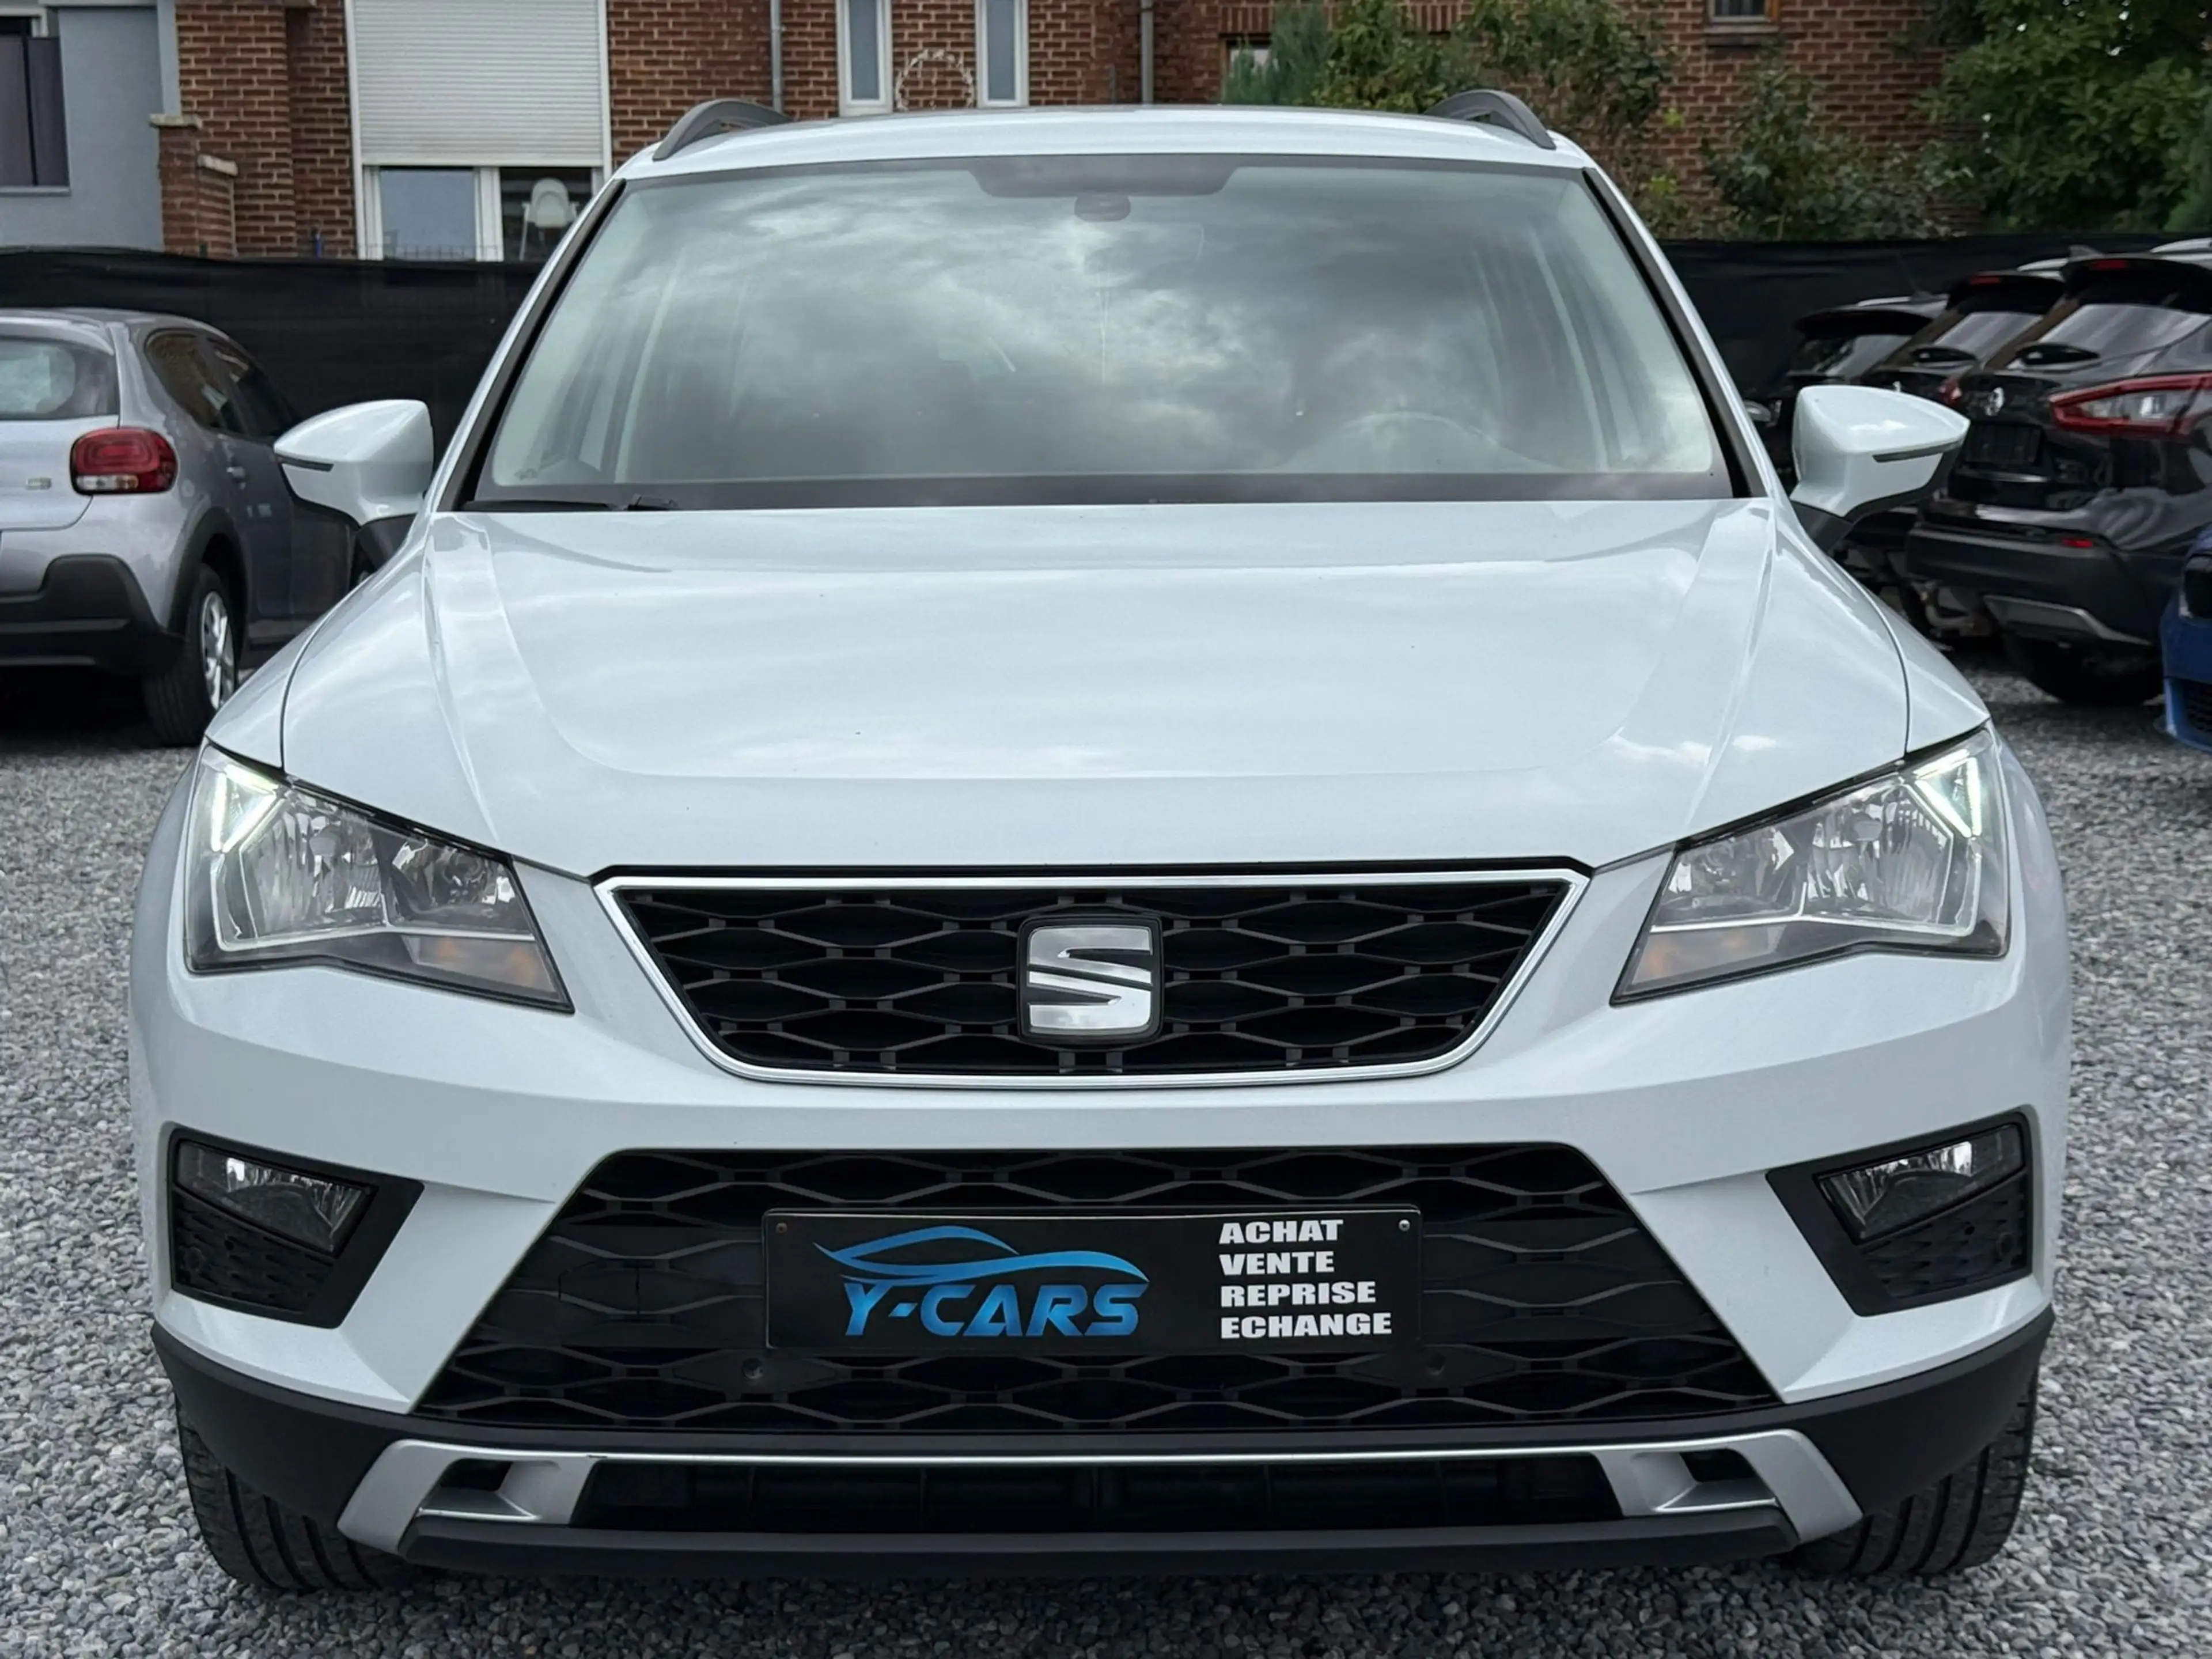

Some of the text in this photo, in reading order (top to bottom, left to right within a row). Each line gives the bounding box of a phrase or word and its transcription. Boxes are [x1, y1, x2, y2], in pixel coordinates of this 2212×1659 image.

[1218, 1218, 1344, 1245] ACHAT
[1219, 1251, 1335, 1276] VENTE
[1220, 1281, 1377, 1308] REPRISE
[843, 1282, 1146, 1337] Y-CARS
[1221, 1312, 1393, 1339] ECHANGE
